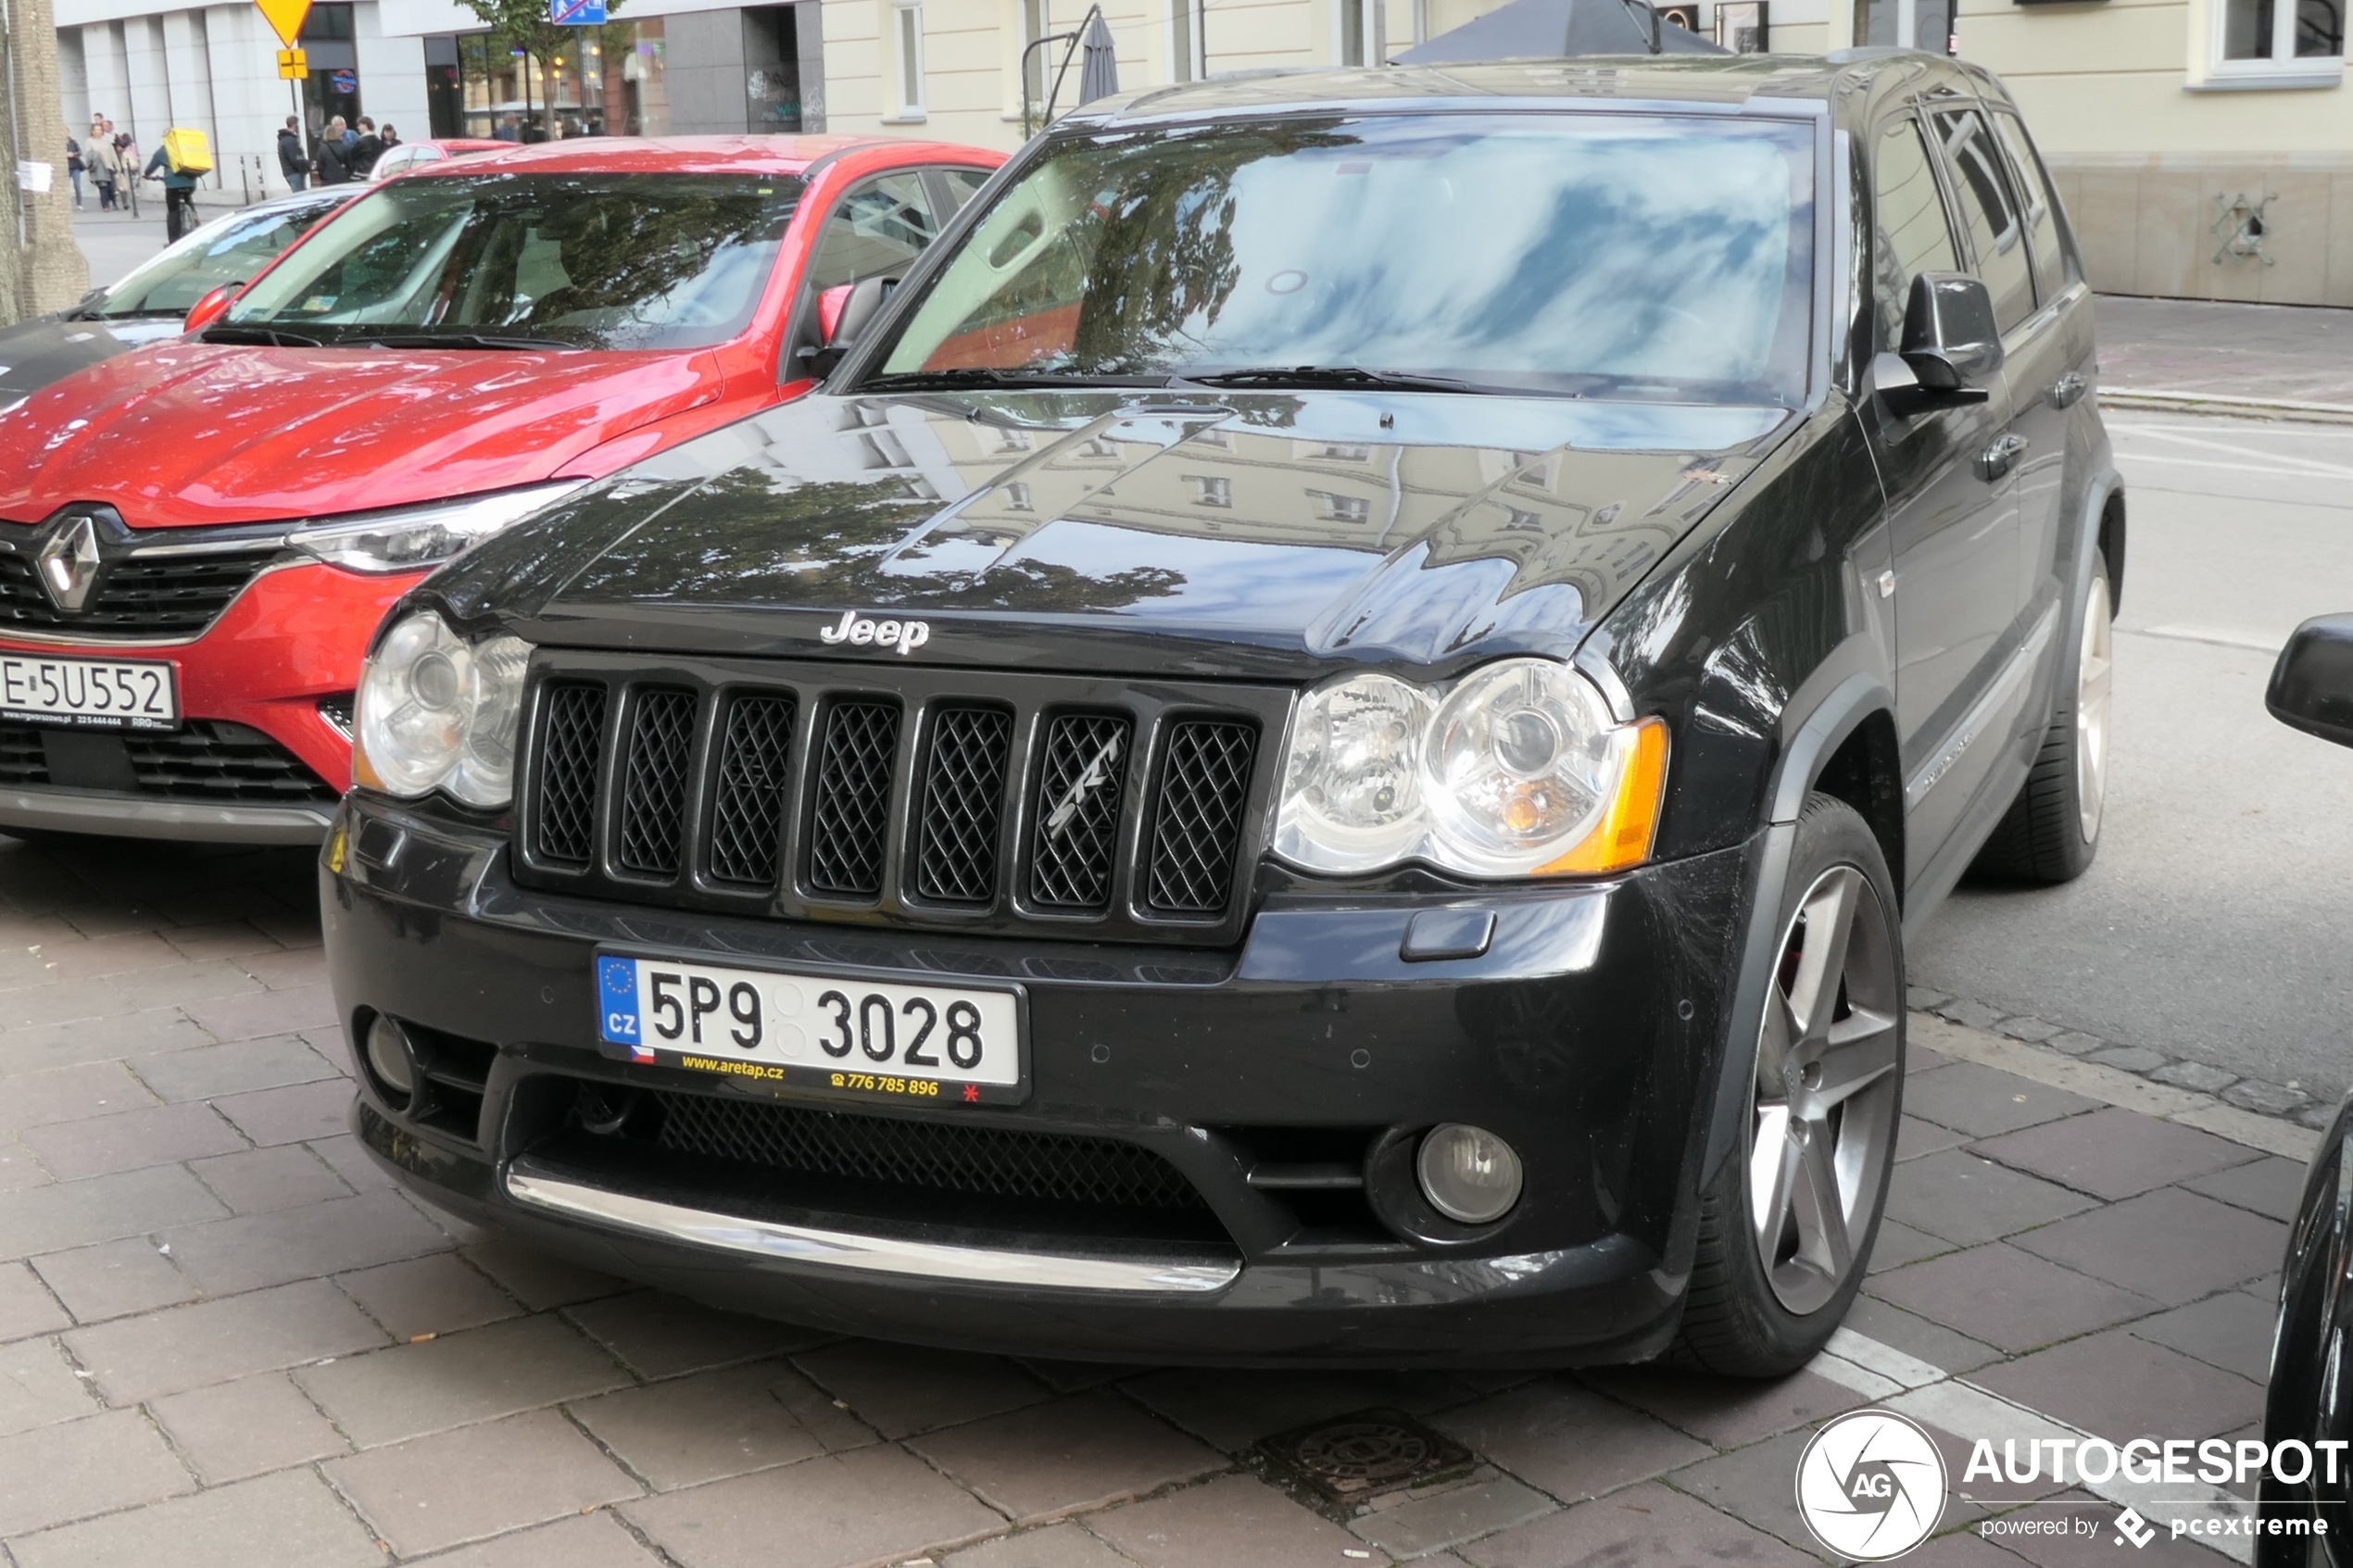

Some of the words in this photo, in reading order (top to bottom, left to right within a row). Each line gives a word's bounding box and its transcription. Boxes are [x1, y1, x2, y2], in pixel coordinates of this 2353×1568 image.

[820, 610, 930, 656] Jeep
[40, 664, 164, 713] 5U552
[609, 1012, 636, 1035] CZ
[650, 971, 762, 1049] 5P9
[817, 989, 984, 1070] 3028
[682, 1055, 785, 1080] www.aretap.cz
[847, 1073, 875, 1090] 776
[877, 1076, 906, 1093] 785
[908, 1079, 938, 1097] 896
